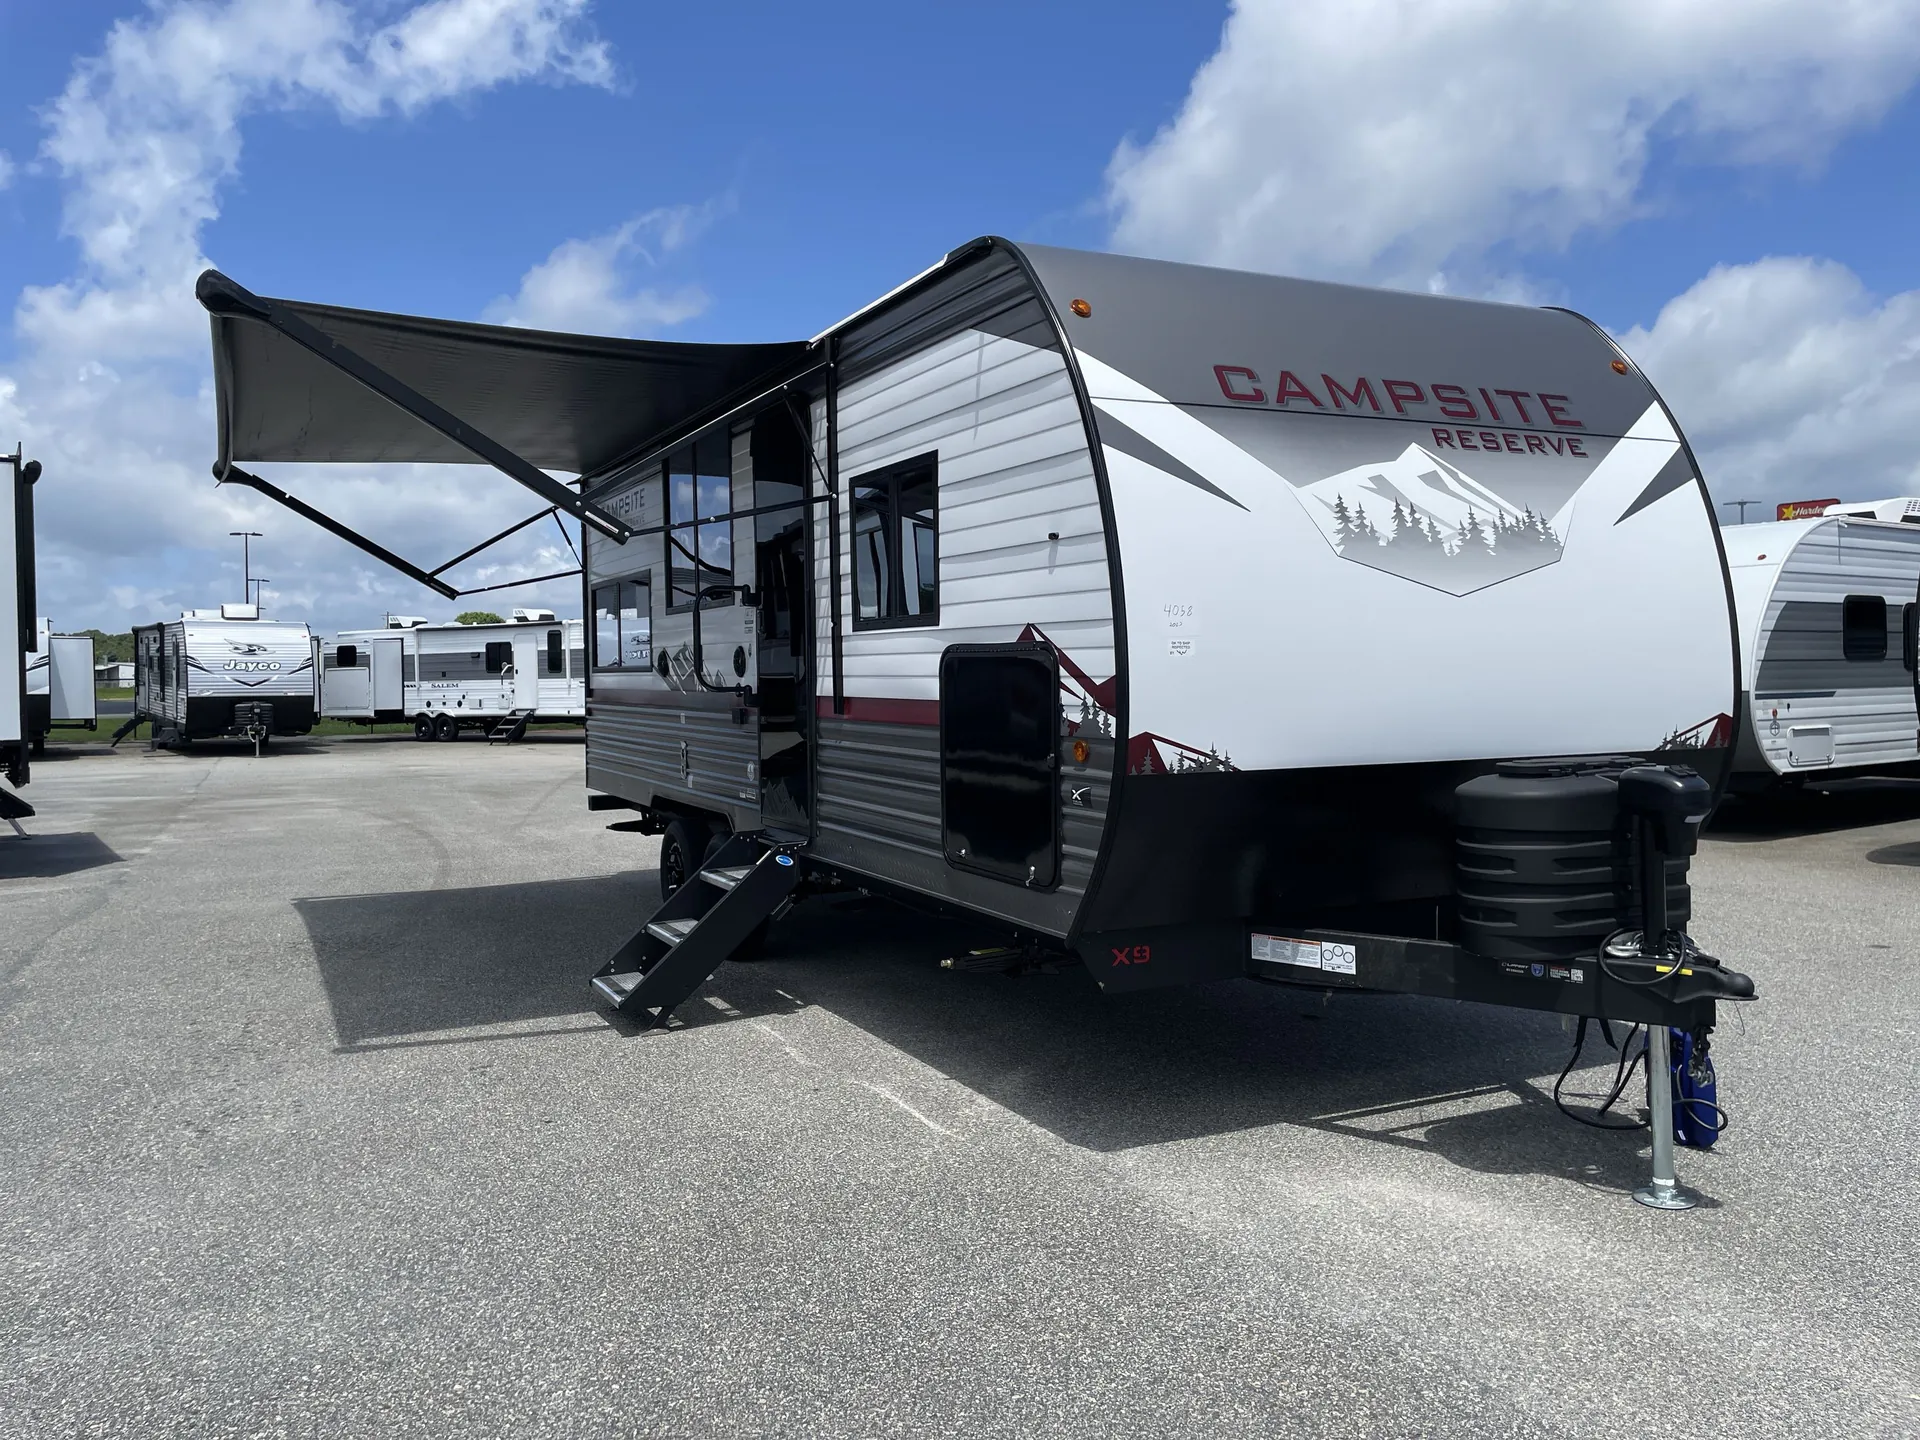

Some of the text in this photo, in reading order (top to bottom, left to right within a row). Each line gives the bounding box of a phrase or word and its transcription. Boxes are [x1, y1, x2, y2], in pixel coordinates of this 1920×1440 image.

[1213, 364, 1584, 427] CAMPSITE
[1432, 428, 1589, 458] RESERVE
[602, 488, 645, 518] AMPSITE
[223, 659, 281, 672] Jayco
[1111, 945, 1151, 967] X9
